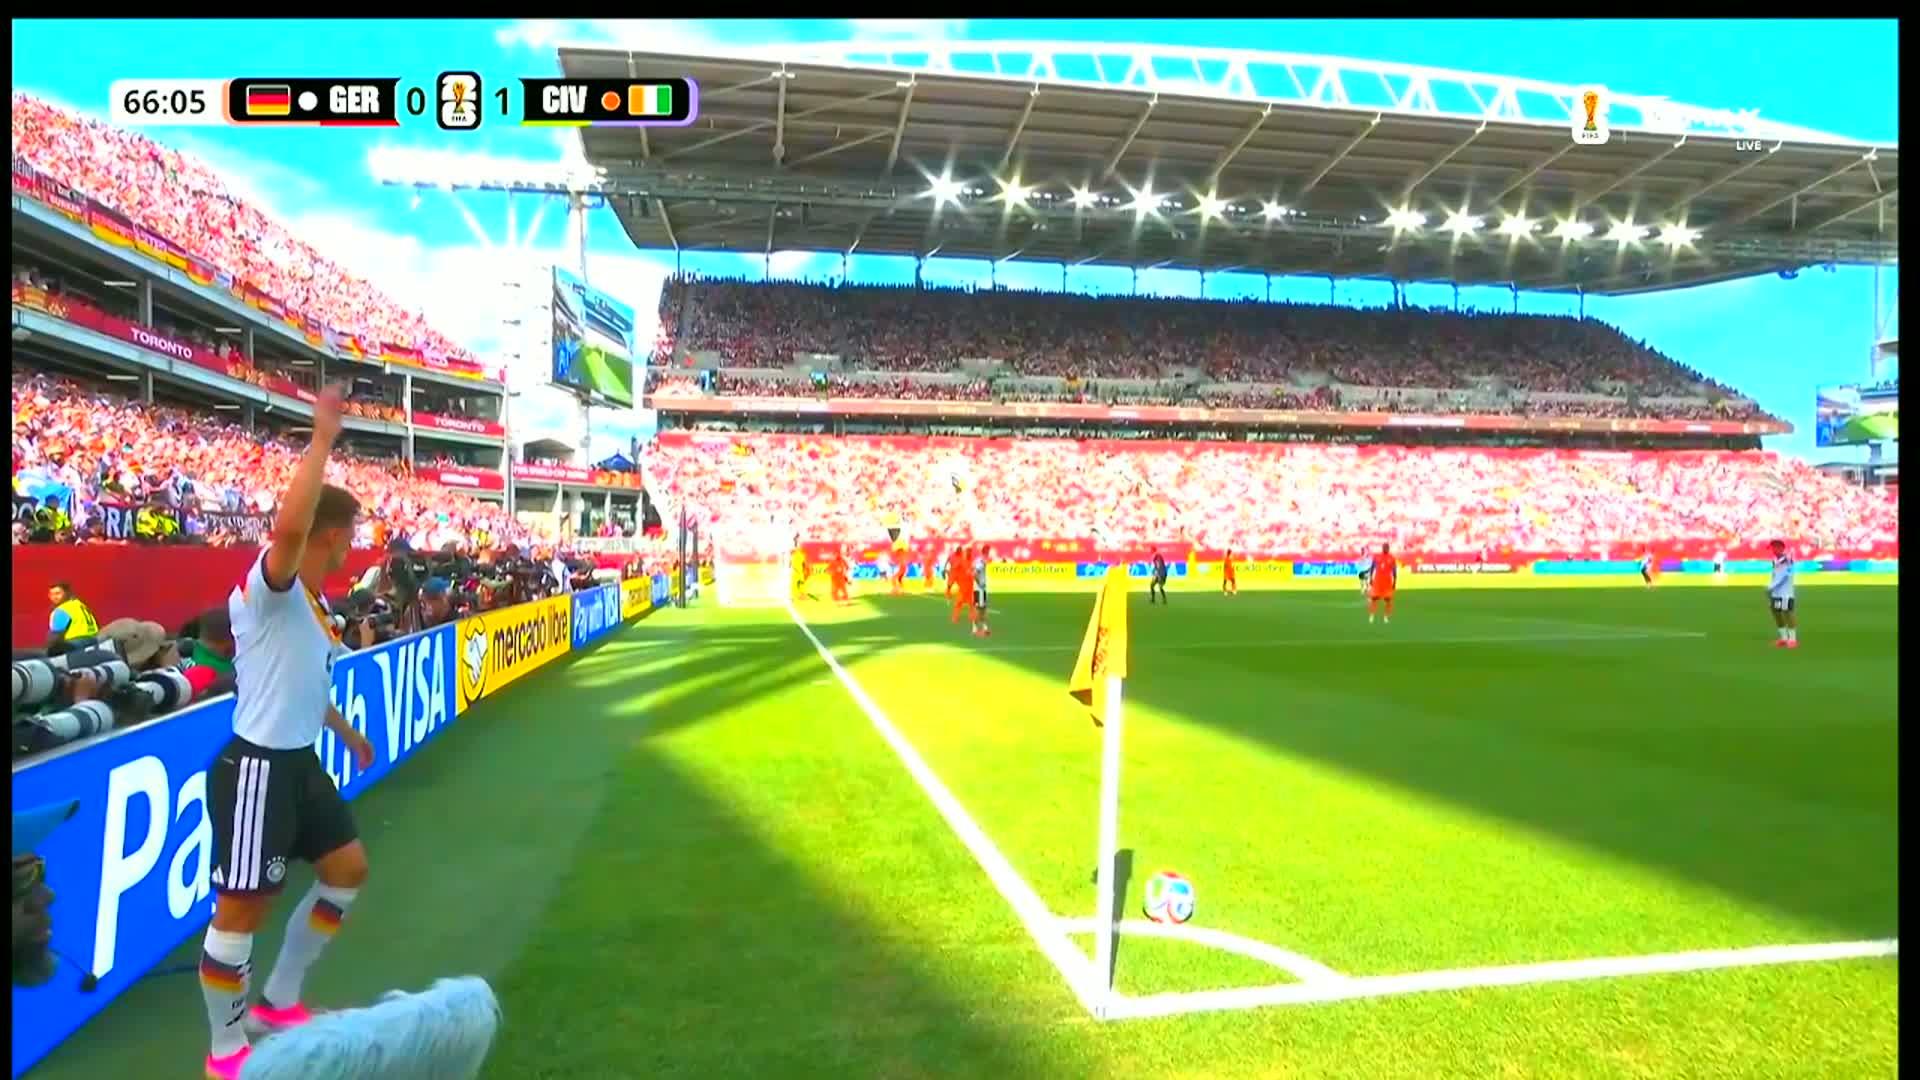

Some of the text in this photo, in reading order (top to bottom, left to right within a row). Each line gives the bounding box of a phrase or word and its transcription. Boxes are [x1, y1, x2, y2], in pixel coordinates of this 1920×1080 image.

[130, 326, 194, 359] TORONTO
[434, 417, 485, 432] TORONTO
[492, 602, 568, 676] mercado libre
[574, 597, 588, 643] Pay
[93, 754, 215, 980] Pa
[372, 632, 446, 764] VISA
